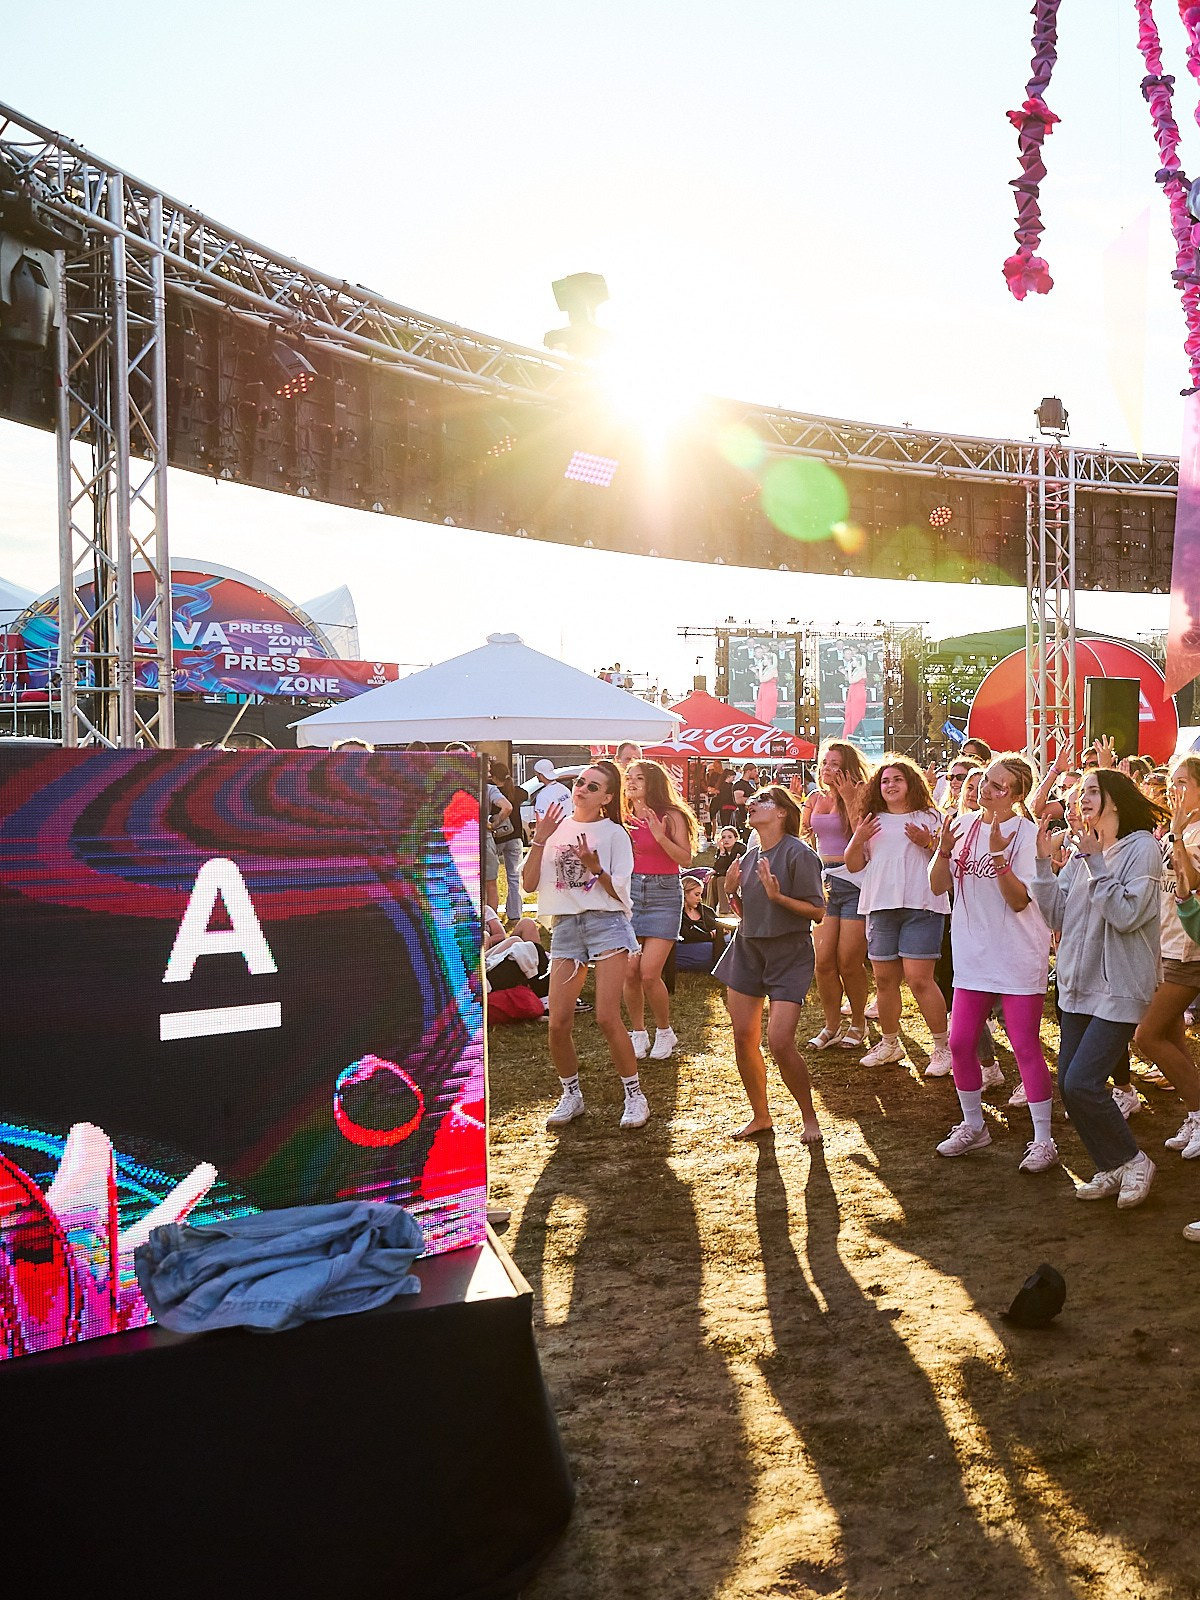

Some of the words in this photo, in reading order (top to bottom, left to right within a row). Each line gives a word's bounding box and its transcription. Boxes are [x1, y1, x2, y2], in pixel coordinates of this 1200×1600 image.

[133, 622, 230, 645] VVA
[228, 623, 284, 634] PRESS
[267, 635, 313, 647] ZONE
[224, 654, 301, 673] PRESS
[278, 676, 340, 693] ZONE
[162, 857, 279, 983] A
